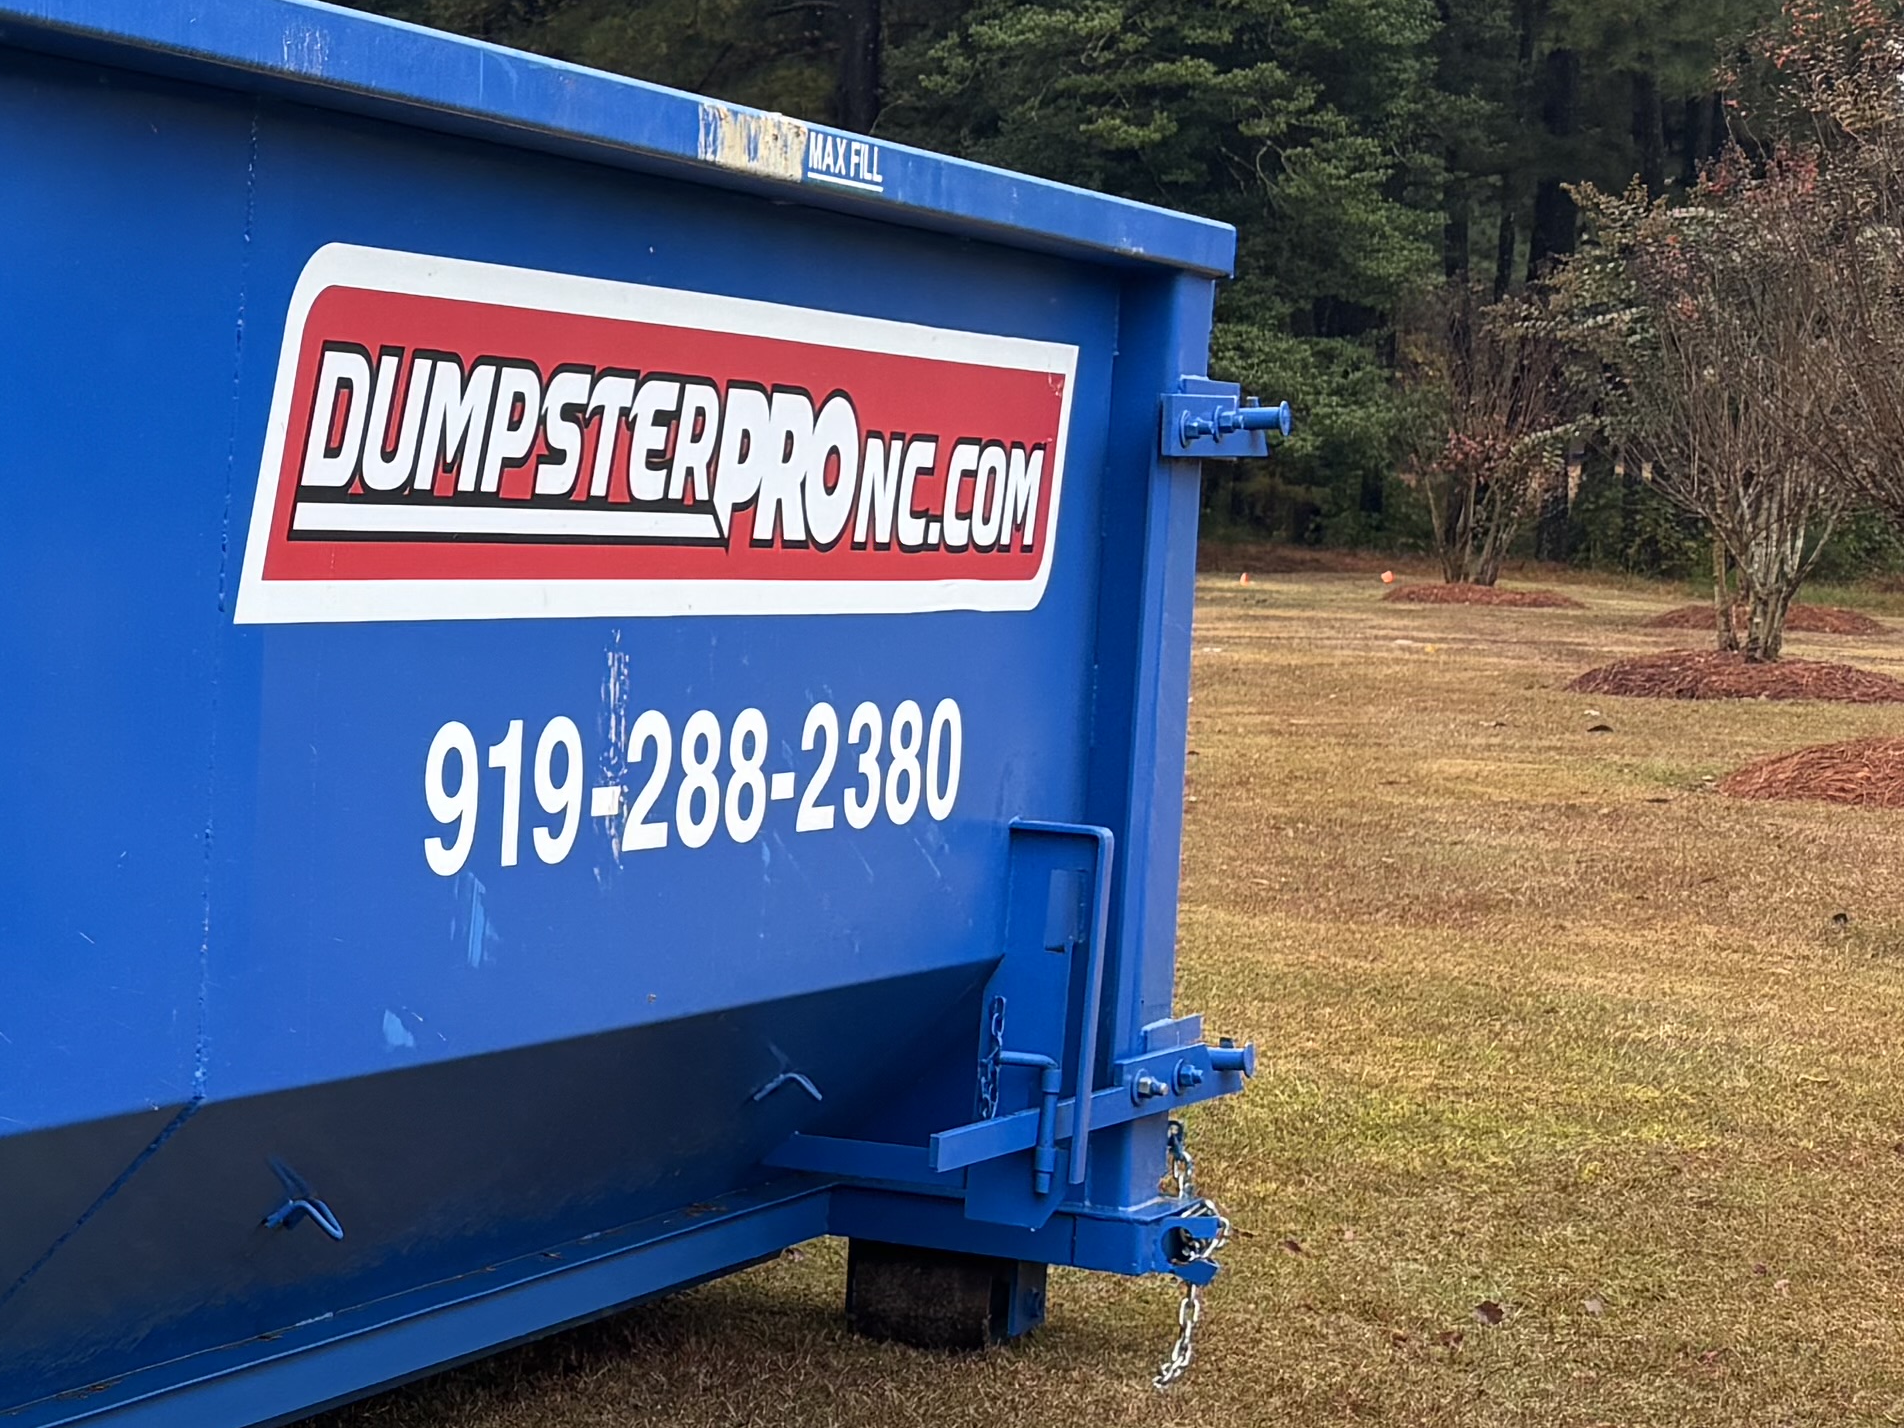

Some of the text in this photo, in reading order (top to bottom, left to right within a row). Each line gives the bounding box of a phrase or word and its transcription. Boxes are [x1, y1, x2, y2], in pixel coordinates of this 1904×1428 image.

[807, 130, 883, 183] MAX FILL
[296, 347, 1047, 549] DUMPSTERPRONC.COM
[423, 697, 963, 877] 919-288-2380
